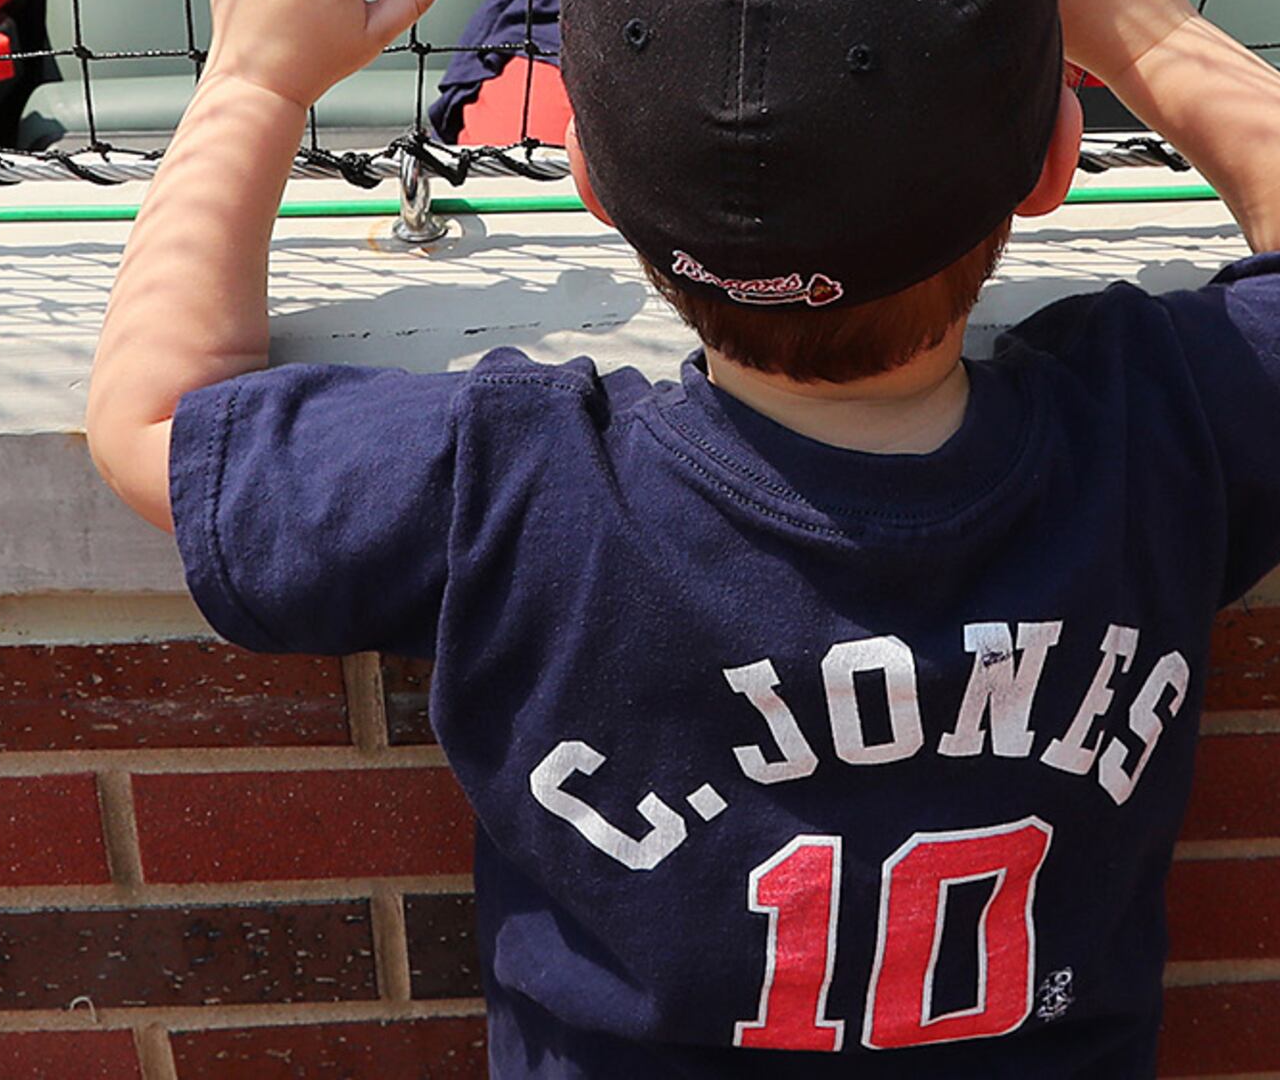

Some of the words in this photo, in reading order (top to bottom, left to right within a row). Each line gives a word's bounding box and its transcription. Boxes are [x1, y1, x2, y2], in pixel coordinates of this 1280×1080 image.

[530, 740, 728, 870] C.
[723, 621, 1189, 805] JONES
[732, 815, 1054, 1052] 10
